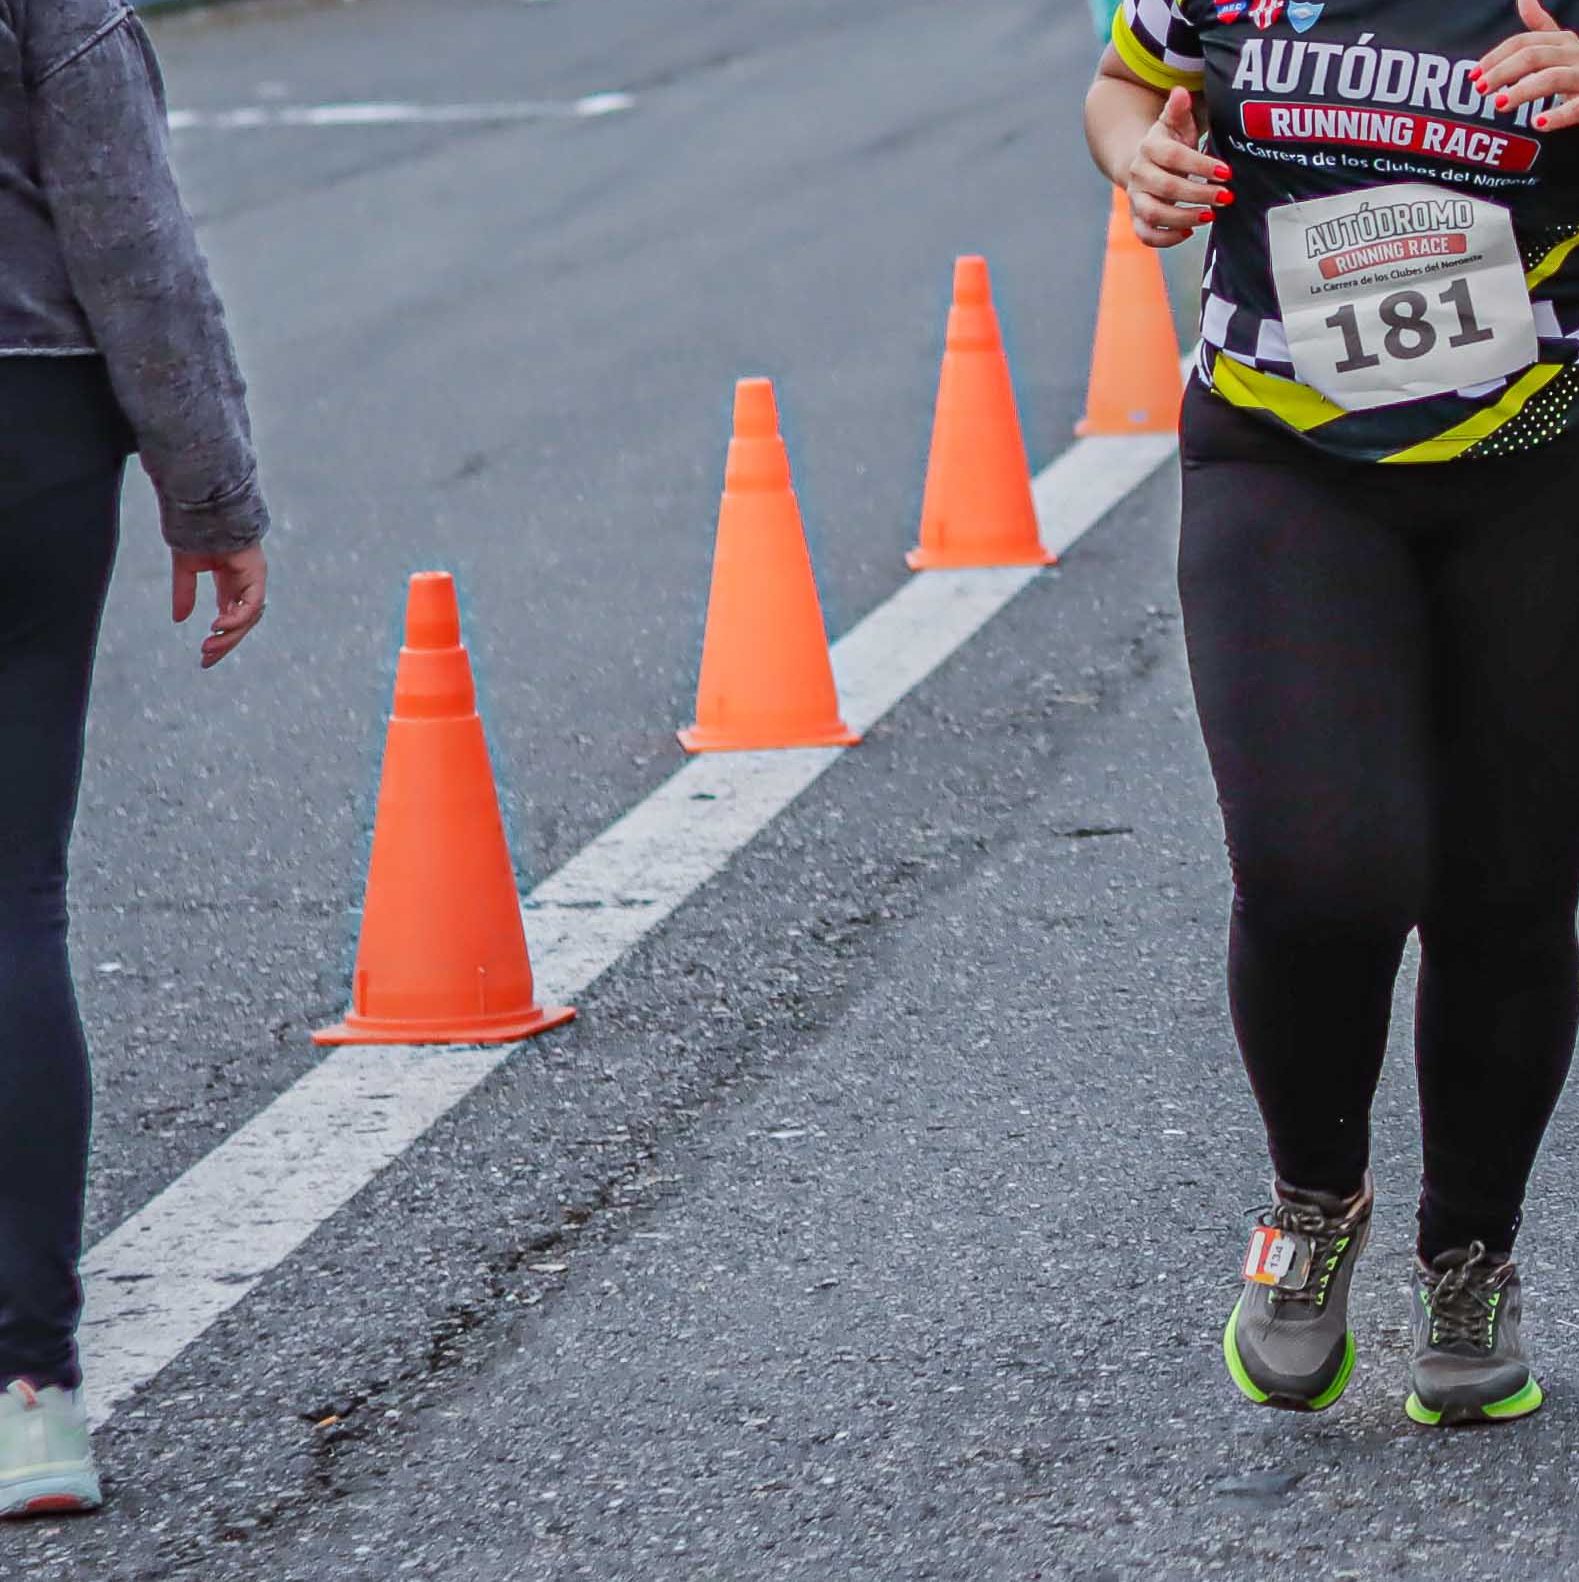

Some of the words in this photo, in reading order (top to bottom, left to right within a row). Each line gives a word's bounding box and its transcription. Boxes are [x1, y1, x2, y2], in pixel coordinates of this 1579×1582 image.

[1270, 107, 1414, 147] RUNNING
[1422, 120, 1509, 167] RACE
[1313, 151, 1336, 167] de
[1341, 153, 1369, 169] los
[1305, 199, 1474, 259] AUTÓDROMO
[1310, 284, 1322, 295] La
[1322, 280, 1358, 293] Carrera
[1360, 275, 1373, 286] de
[1374, 271, 1389, 283] los
[1390, 265, 1423, 279] Clubes
[1424, 262, 1440, 274] del
[1335, 241, 1404, 274] RUNNING
[1408, 236, 1450, 256] RACE
[1326, 278, 1494, 373] 181
